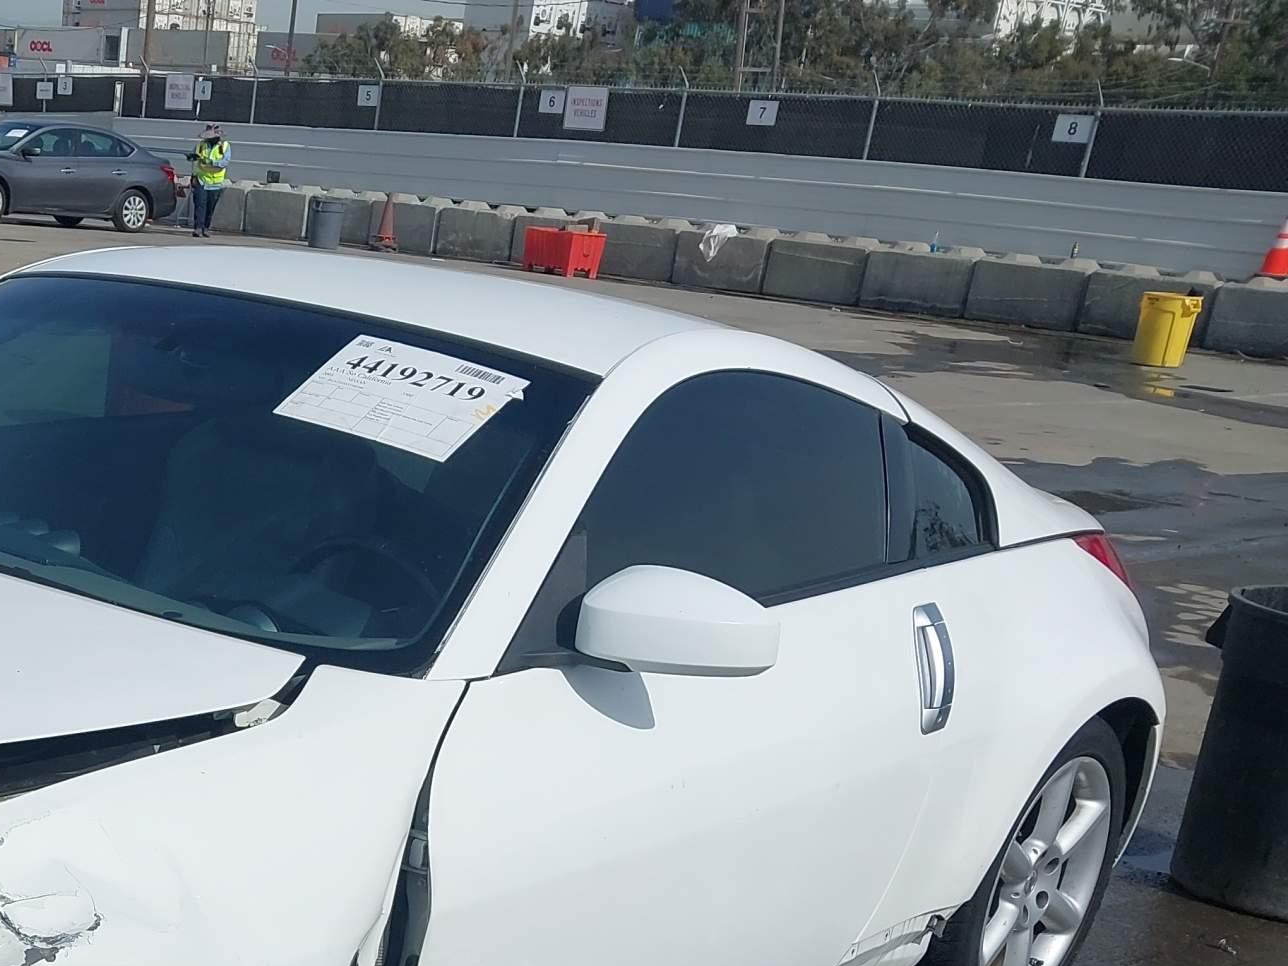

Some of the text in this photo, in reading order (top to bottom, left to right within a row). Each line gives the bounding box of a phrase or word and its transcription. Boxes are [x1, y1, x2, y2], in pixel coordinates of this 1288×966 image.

[29, 40, 53, 52] OOCL
[62, 81, 67, 91] 3
[200, 85, 206, 95] 4
[365, 90, 371, 101] 5
[549, 96, 556, 108] 6
[759, 106, 767, 119] 7
[1067, 121, 1078, 135] 8
[346, 355, 486, 401] 44192719
